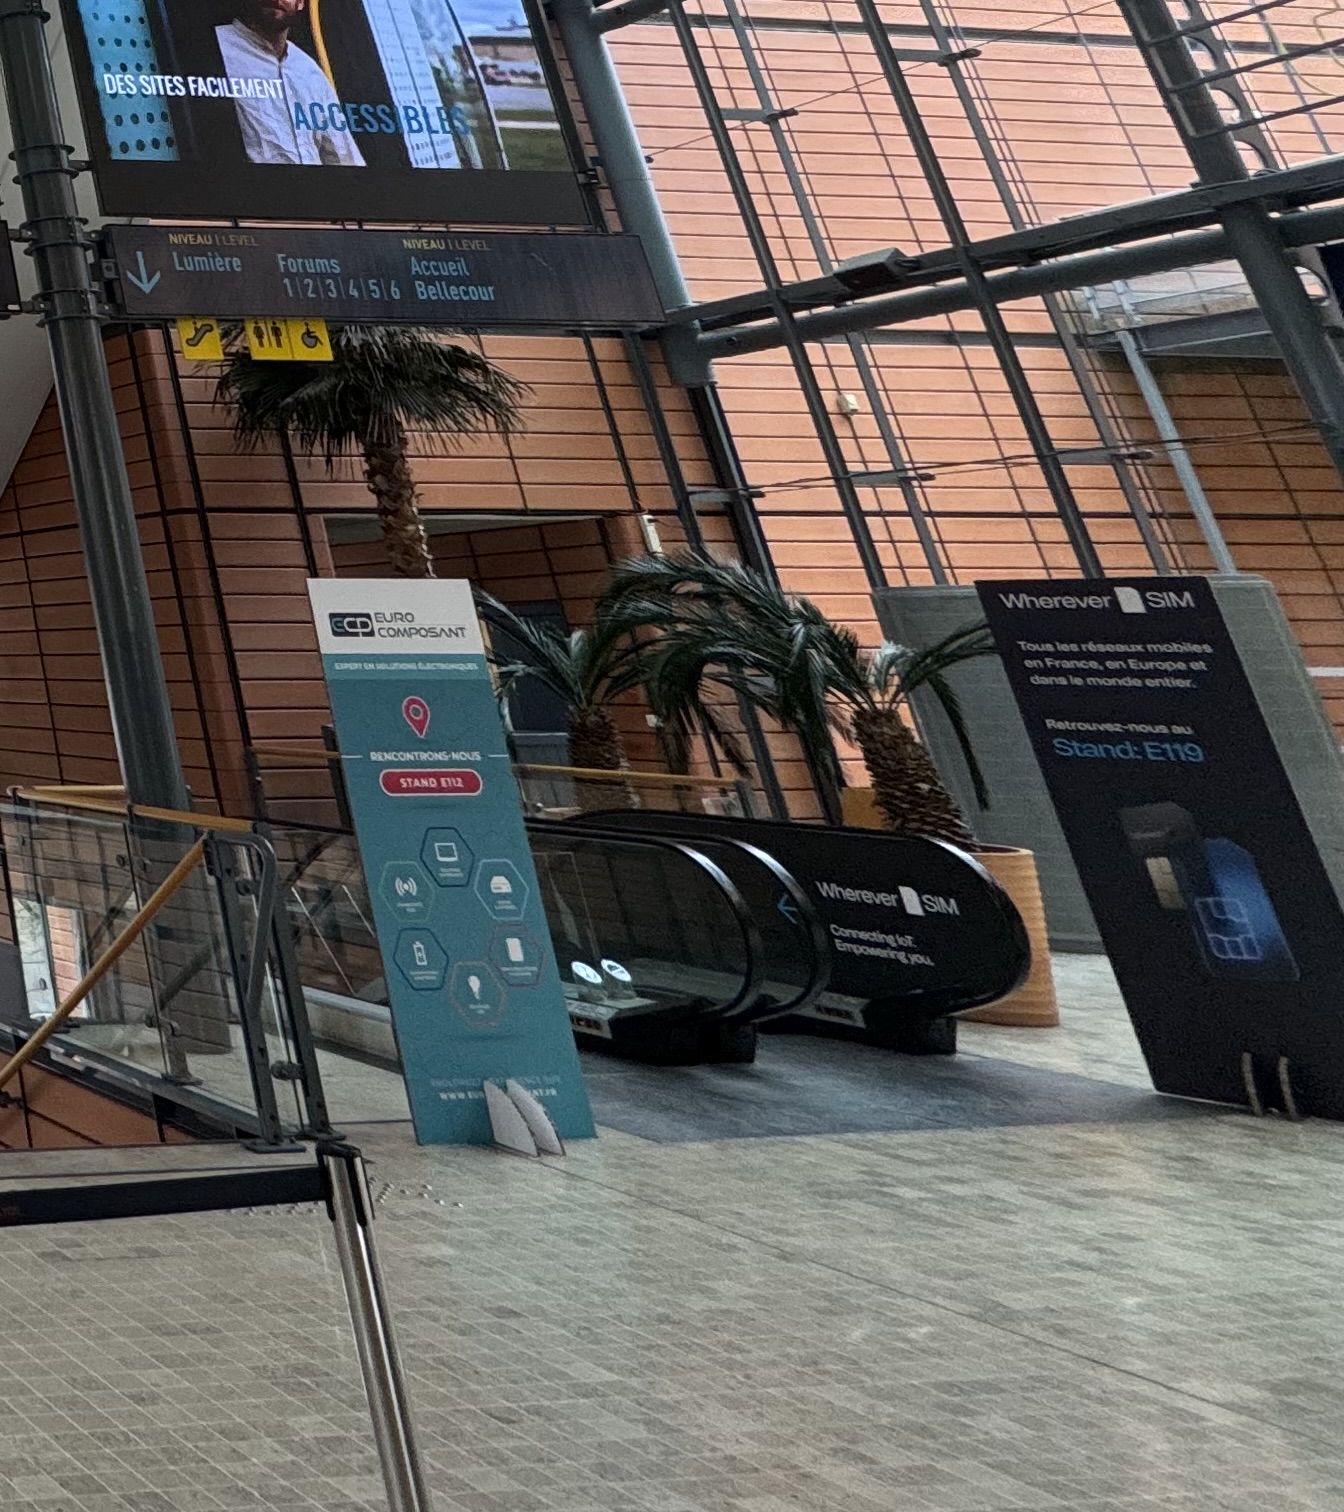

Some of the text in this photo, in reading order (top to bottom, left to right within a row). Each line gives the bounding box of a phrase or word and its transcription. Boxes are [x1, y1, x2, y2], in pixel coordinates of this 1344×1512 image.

[103, 73, 285, 100] DES SITES FACILEMENT
[293, 101, 471, 136] ACCESSIBLES
[168, 233, 261, 247] NIVEAU LEVEL
[401, 238, 494, 251] NIVEAU LEVEL
[172, 251, 243, 273] Lumière
[277, 253, 342, 275] Forums
[411, 255, 471, 277] Accueil
[414, 279, 496, 301] Bellecour
[998, 591, 1196, 610] Wherever SIM
[374, 611, 416, 624] EURO
[378, 626, 467, 639] COMPOSANT
[1016, 640, 1055, 653] Tous
[1147, 641, 1213, 655] mobiles
[1128, 658, 1187, 672] Europe
[1052, 738, 1206, 763] Stand: E119
[399, 777, 438, 788] STAND
[814, 880, 961, 916] Wherever SIM
